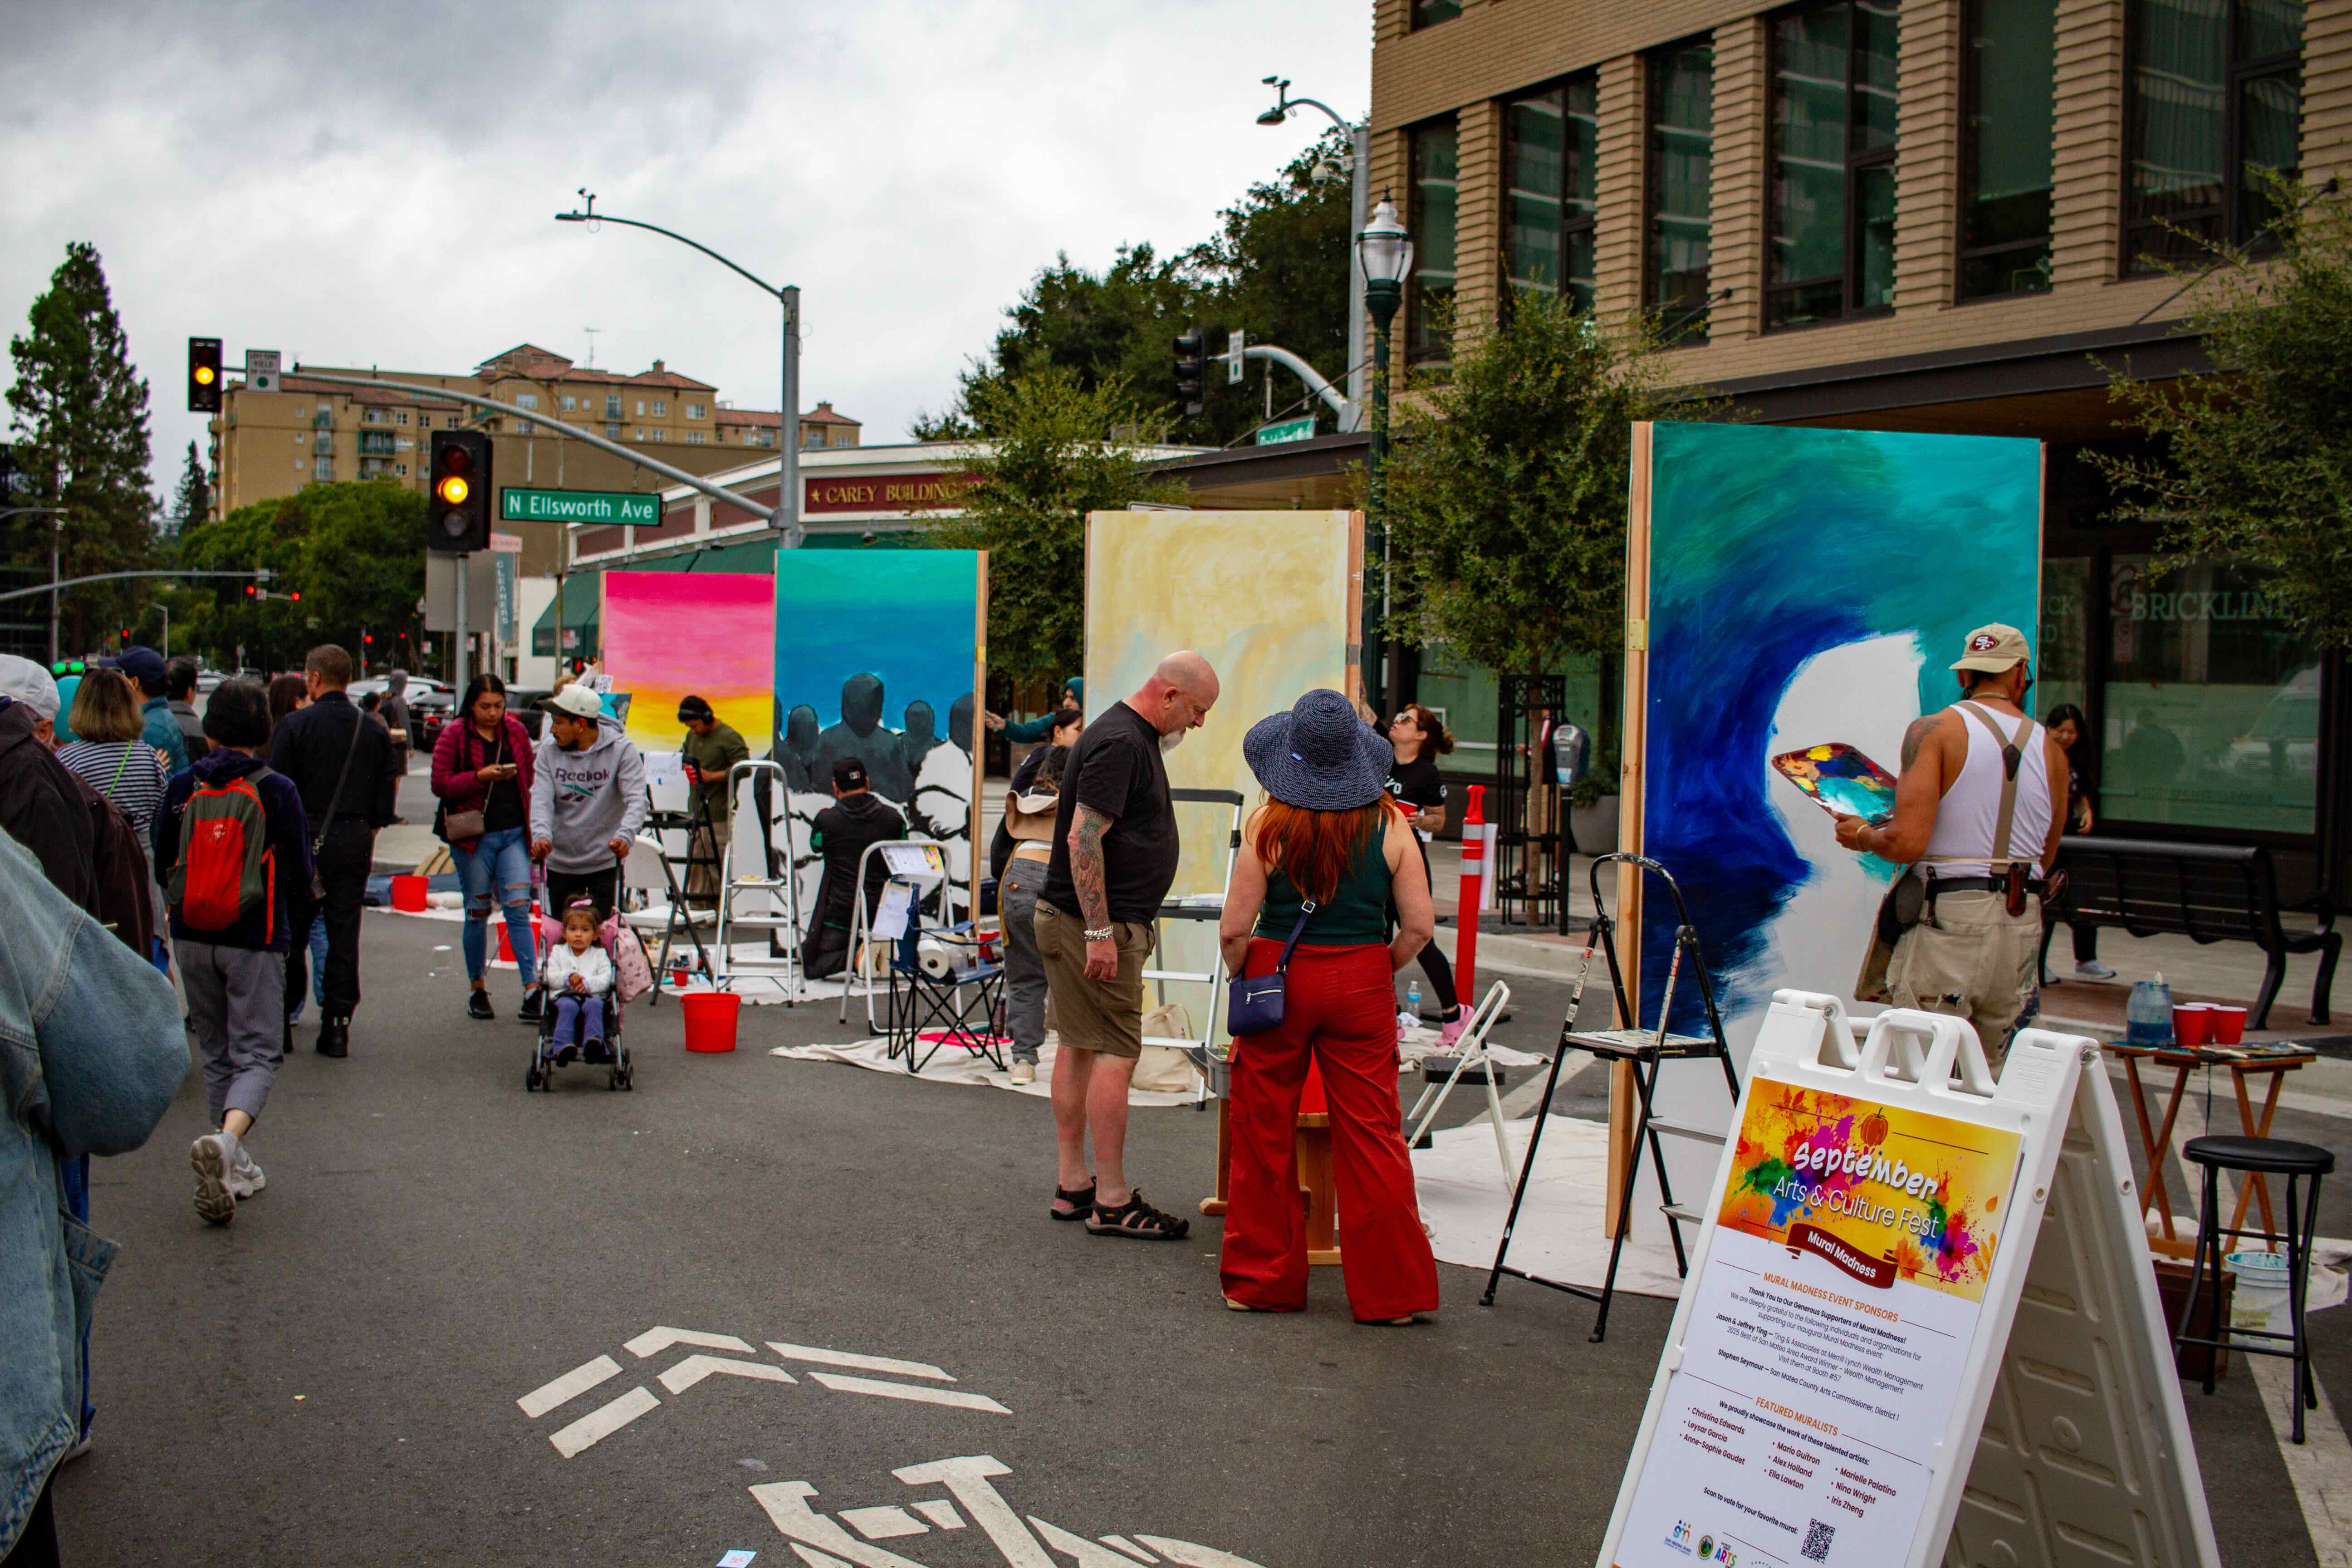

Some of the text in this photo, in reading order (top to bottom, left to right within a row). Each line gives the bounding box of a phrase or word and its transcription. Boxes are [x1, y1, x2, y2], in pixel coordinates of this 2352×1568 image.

[509, 495, 653, 519] N Ellsworth Ave
[826, 486, 878, 503] CAREY
[886, 483, 957, 501] BUILDING
[555, 768, 610, 782] Reebok
[1773, 1176, 1940, 1238] Arts & Culture Fest
[1808, 1230, 1877, 1278] Mural Madness
[1764, 1272, 1898, 1322] MURAL MADNESS EVENT SPONSORS
[1749, 1286, 1765, 1298] Thank
[1766, 1292, 1776, 1301] You
[1783, 1298, 1793, 1307] Our
[1793, 1302, 1820, 1315] Generous
[1820, 1310, 1852, 1326] Supporters
[1858, 1323, 1877, 1334] Mural
[1876, 1328, 1906, 1344] Madness!
[1749, 1299, 1766, 1311] deeply
[1766, 1305, 1788, 1316] grateful
[1794, 1313, 1804, 1322] the
[1804, 1316, 1829, 1332] following
[1829, 1324, 1860, 1340] individuals
[1860, 1336, 1872, 1345] and
[1872, 1340, 1912, 1358] organizations
[1912, 1352, 1921, 1361] for
[1758, 1312, 1786, 1328] supporting
[1796, 1324, 1823, 1338] inaugural
[1823, 1333, 1839, 1344] Mural
[1839, 1338, 1865, 1353] Madness
[1865, 1348, 1884, 1359] event:
[1715, 1313, 1731, 1323] Jason
[1737, 1320, 1755, 1333] Jeffrey
[1756, 1326, 1768, 1338] Ting
[1774, 1333, 1785, 1344] Ting
[1790, 1339, 1820, 1354] Associates
[1827, 1351, 1845, 1362] Merrill
[1844, 1357, 1862, 1368] Lynch
[1862, 1363, 1883, 1376] Wealth
[1883, 1370, 1924, 1391] Management
[1727, 1326, 1740, 1336] 2025
[1740, 1331, 1751, 1340] Best
[1758, 1337, 1769, 1346] San
[1769, 1341, 1786, 1352] Mateo
[1786, 1347, 1799, 1357] Area
[1799, 1352, 1818, 1363] Award
[1818, 1358, 1838, 1370] Winner
[1844, 1367, 1864, 1380] Wealth
[1864, 1375, 1904, 1394] Management
[1779, 1354, 1789, 1364] Visit
[1790, 1359, 1804, 1369] them
[1812, 1366, 1828, 1378] Booth
[1829, 1372, 1841, 1382] #57
[1718, 1348, 1740, 1362] Stephen
[1740, 1357, 1764, 1371] Seymour
[1769, 1368, 1780, 1377] San
[1780, 1372, 1798, 1383] Mateo
[1798, 1379, 1819, 1393] County
[1819, 1386, 1831, 1396] Arts
[1832, 1391, 1873, 1412] Commissioner,
[1875, 1406, 1896, 1420] District
[1687, 1420, 1727, 1442] Leysar Garcia
[1692, 1407, 1745, 1435] Christina Edwards
[1756, 1397, 1838, 1436] FEATURED MURALISTS
[1719, 1400, 1728, 1409] We
[1727, 1405, 1749, 1419] proudly
[1749, 1413, 1776, 1428] showcase
[1777, 1423, 1786, 1432] the
[1786, 1428, 1801, 1438] work
[1807, 1435, 1823, 1447] these
[1824, 1442, 1849, 1457] talented
[1848, 1453, 1870, 1465] artists:
[1683, 1433, 1745, 1465] Anne-Sophie Gaudet
[1777, 1441, 1820, 1465] Mario Guitron
[1768, 1469, 1803, 1490] Ella Lawton
[1772, 1455, 1813, 1477] Alex Holland
[1835, 1481, 1876, 1504] Nina Wright
[1840, 1467, 1896, 1496] Marielle Palatino
[1703, 1487, 1717, 1498] Scan
[1724, 1496, 1735, 1506] vote
[1735, 1500, 1744, 1509] for
[1743, 1506, 1757, 1516] your
[1757, 1510, 1779, 1525] favorite
[1779, 1521, 1798, 1534] mural:
[1831, 1495, 1864, 1518] Iris Zheng
[1714, 1547, 1737, 1567] ARTS
